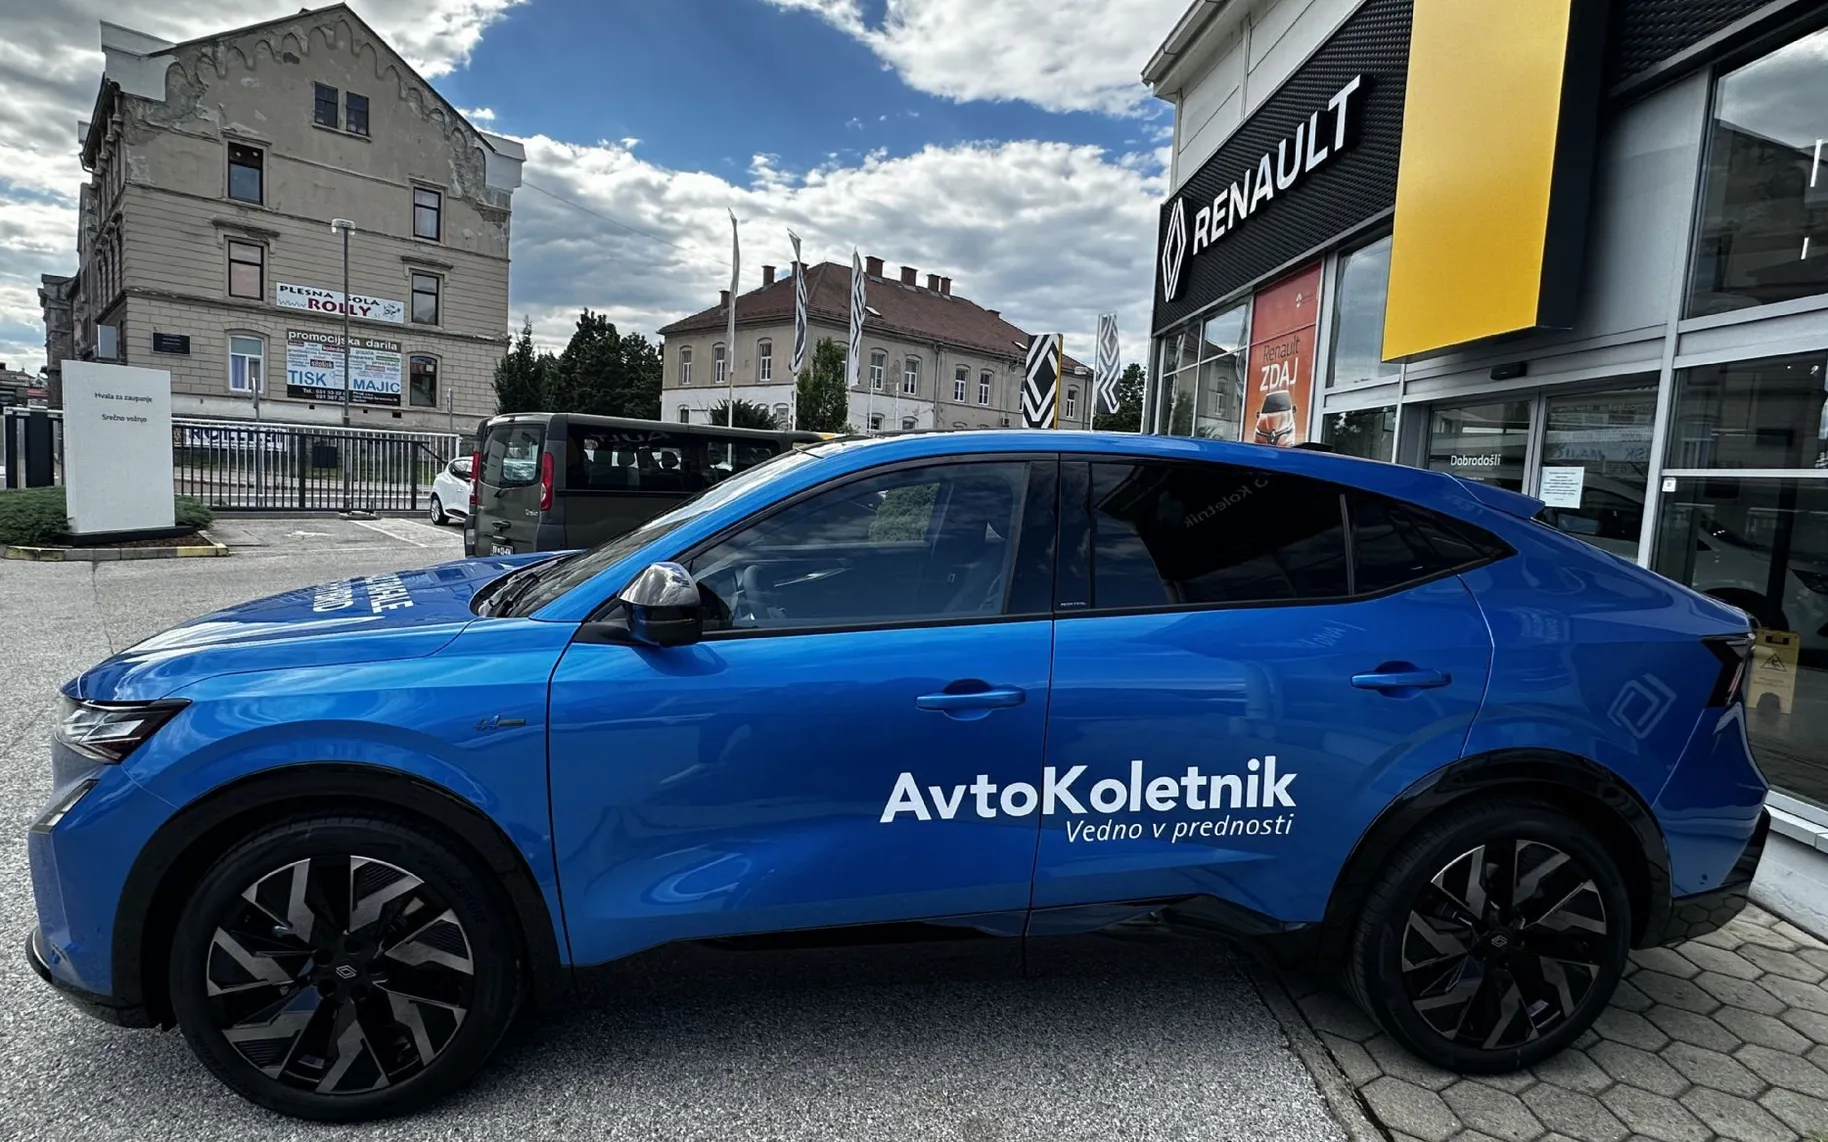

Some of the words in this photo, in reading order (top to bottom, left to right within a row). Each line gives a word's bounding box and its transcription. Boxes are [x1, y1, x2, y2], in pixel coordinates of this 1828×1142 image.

[1193, 74, 1361, 256] RENAULT
[279, 285, 334, 299] PLESNA
[307, 297, 372, 317] ROLLY
[288, 331, 361, 347] promocijska
[365, 339, 398, 351] darila
[1262, 334, 1301, 363] Renault
[287, 369, 327, 387] TISK
[353, 378, 400, 394] MAJIC
[1259, 357, 1299, 392] ZDAJ
[95, 392, 114, 400] Hvala
[1450, 453, 1502, 467] Dobrodošli
[879, 755, 1298, 823] AvtoKoletnik
[1065, 818, 1143, 844] Vedno
[1152, 822, 1170, 839] v
[1171, 813, 1295, 844] prednosti
